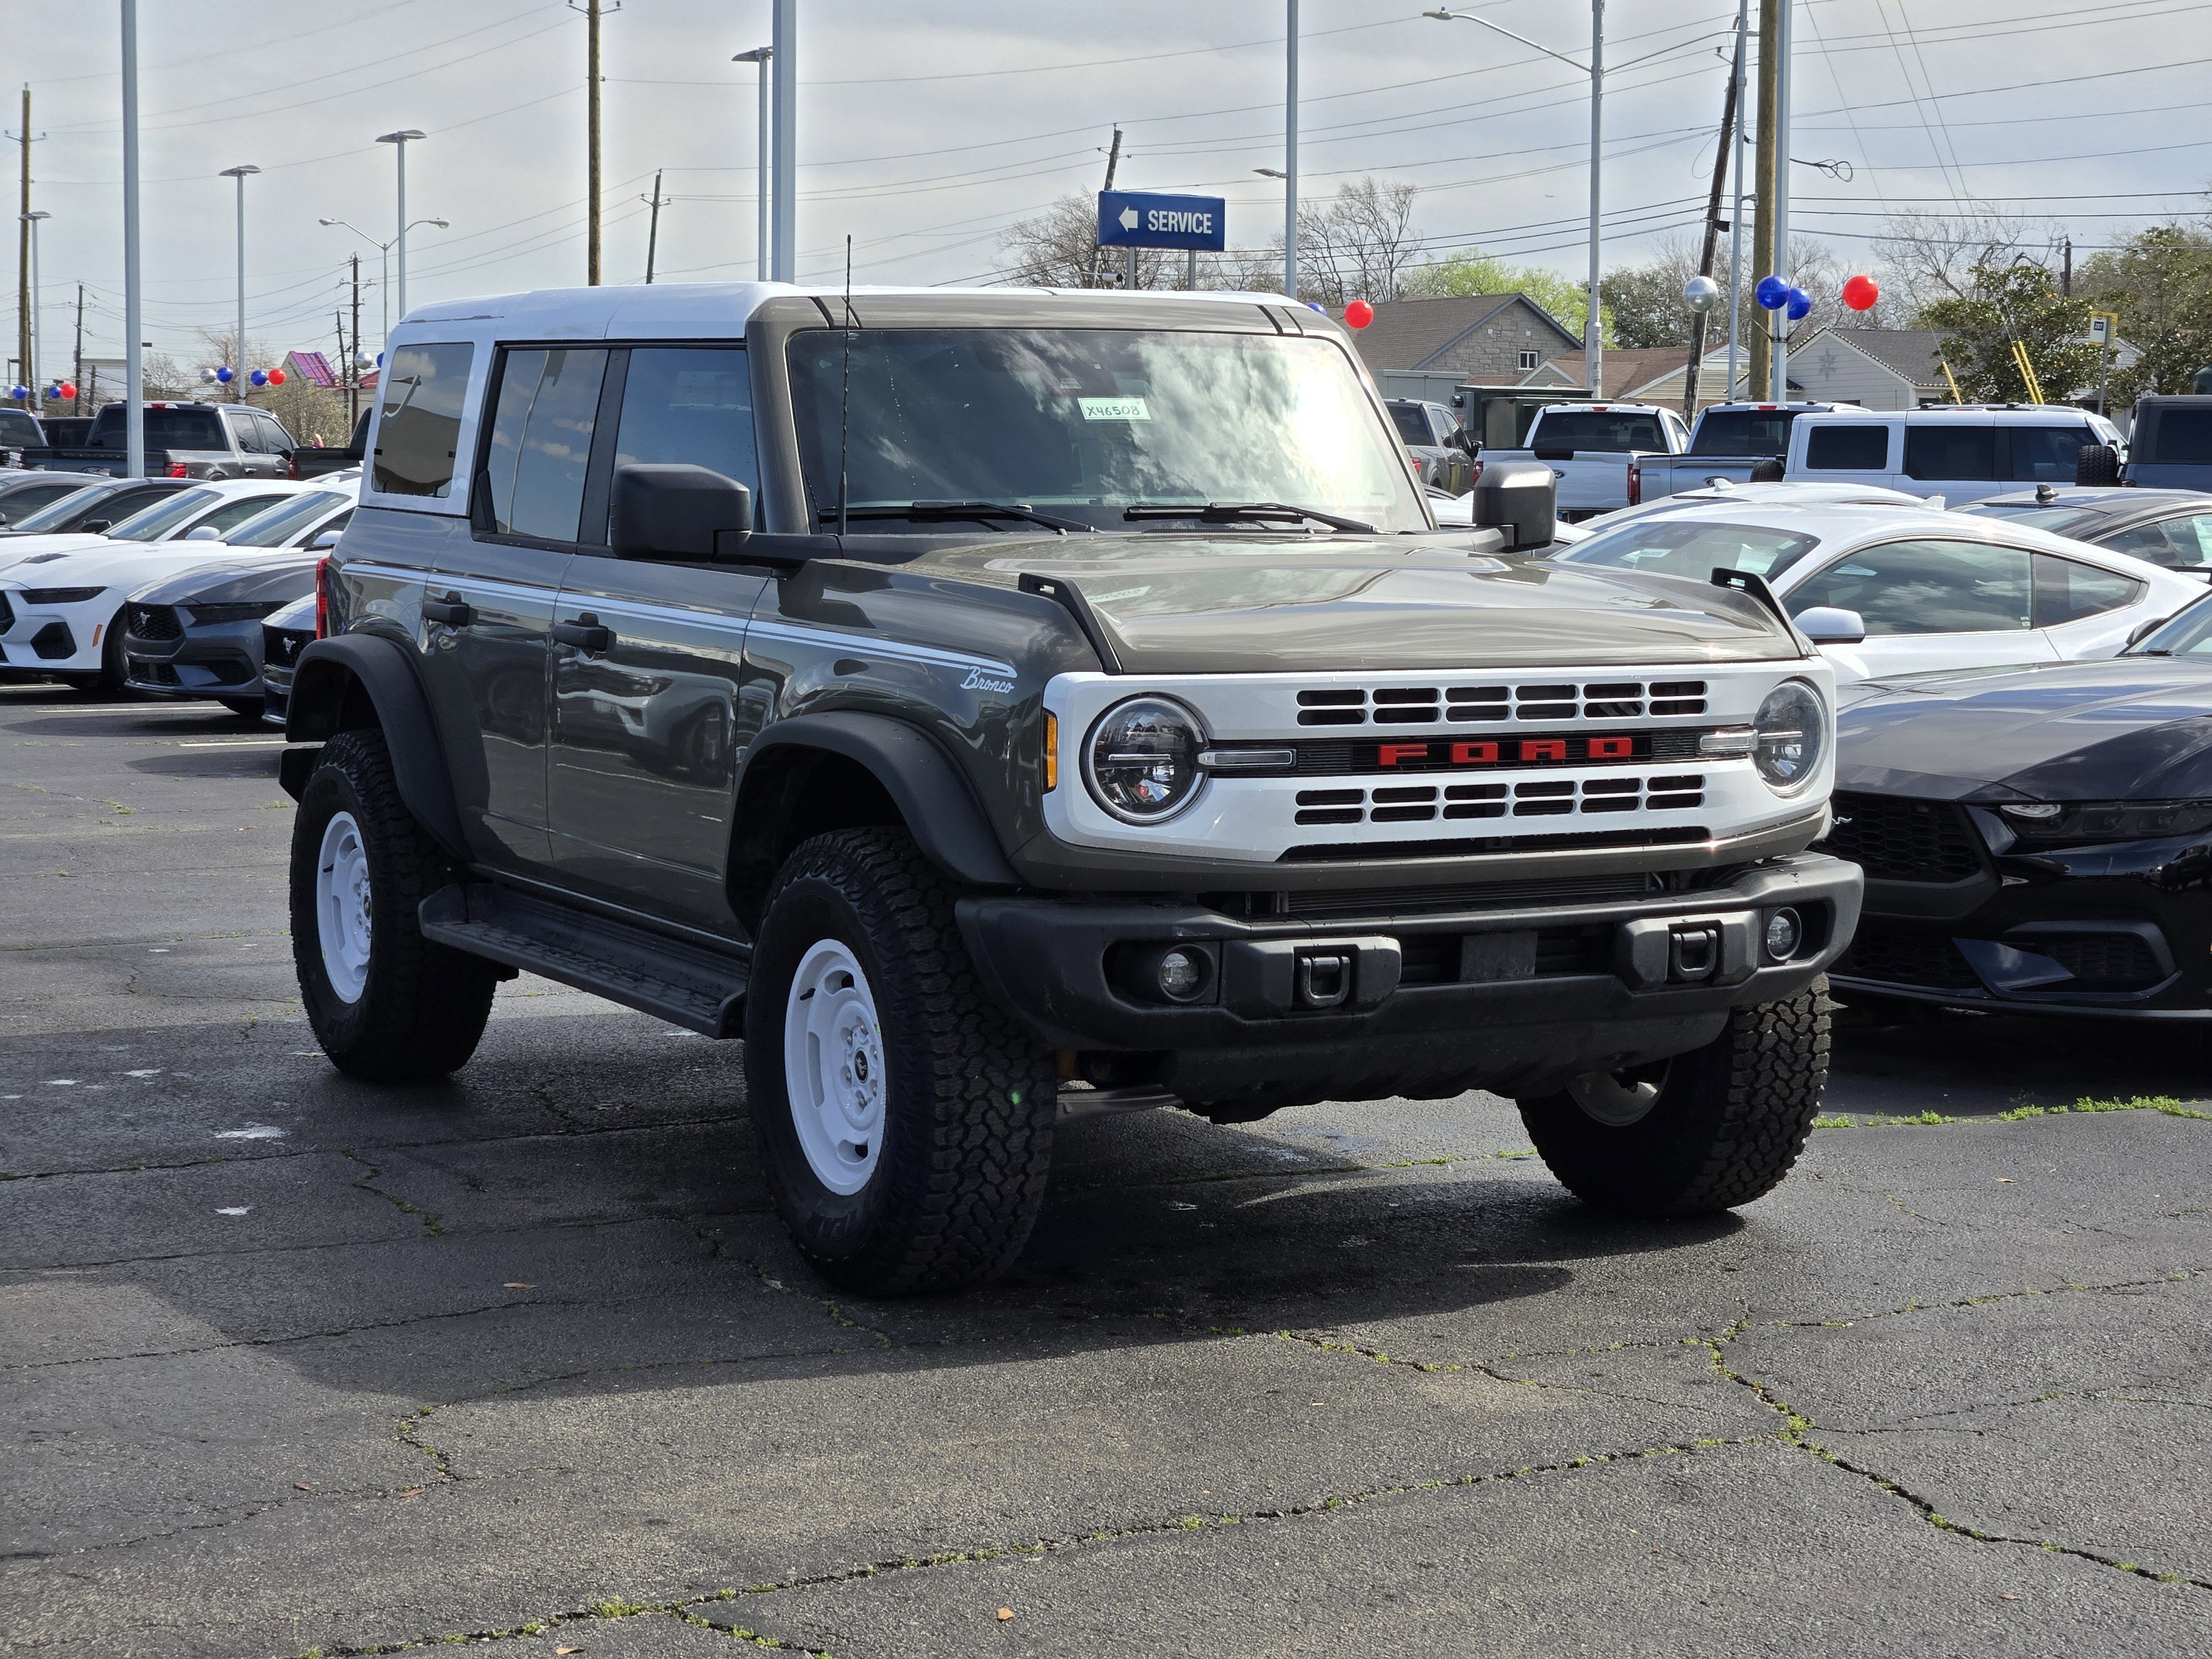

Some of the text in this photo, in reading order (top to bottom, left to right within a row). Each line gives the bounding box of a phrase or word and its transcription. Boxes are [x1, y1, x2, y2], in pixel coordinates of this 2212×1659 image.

[1148, 210, 1212, 234] SERVICE
[1086, 405, 1140, 416] X46508
[959, 665, 1015, 694] Bronco
[1378, 738, 1632, 766] FORD
